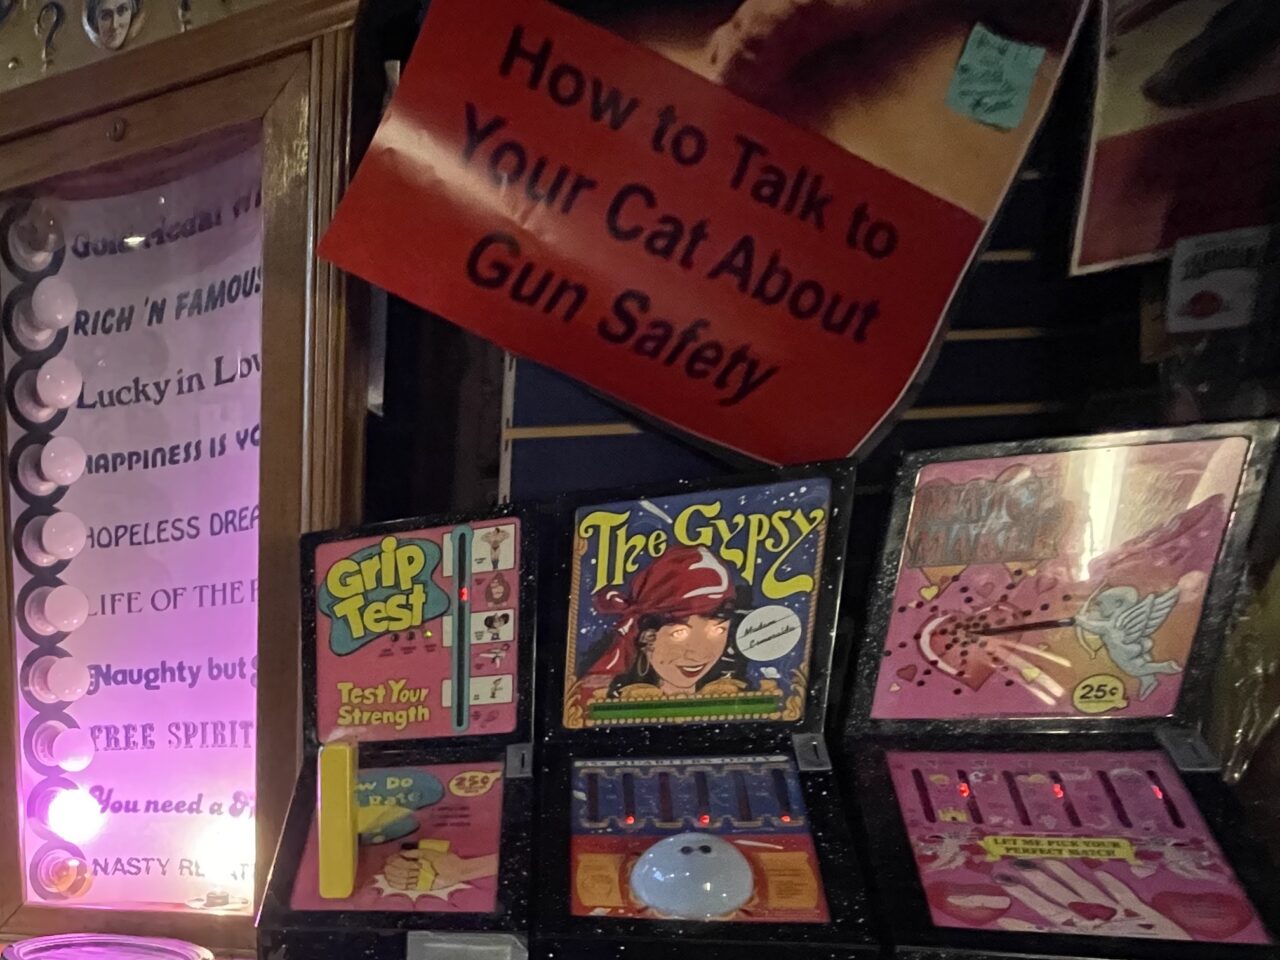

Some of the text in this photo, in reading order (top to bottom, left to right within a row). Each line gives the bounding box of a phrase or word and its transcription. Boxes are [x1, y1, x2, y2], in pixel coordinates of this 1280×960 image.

[498, 24, 899, 261] How to Talk to
[460, 105, 882, 345] Your Cat About
[74, 305, 133, 335] RICH
[144, 297, 166, 326] 'N
[465, 232, 779, 406] Gun Safety
[76, 377, 170, 409] Lucky
[176, 369, 205, 395] in
[210, 434, 226, 458] IS
[327, 536, 425, 600] Grip
[579, 510, 667, 594] The
[674, 502, 824, 599] Gypsy
[151, 587, 187, 611] OF
[192, 581, 244, 608] THE
[333, 584, 425, 639] Test
[86, 661, 201, 695] Naughty
[208, 657, 246, 681] but
[337, 679, 429, 704] Test Your
[90, 720, 254, 751] FREE SPIRIT
[337, 707, 430, 731] Strength
[89, 785, 140, 813] You
[144, 794, 202, 815] need
[209, 800, 224, 816] a
[387, 777, 413, 789] Do
[92, 857, 169, 876] NASTY
